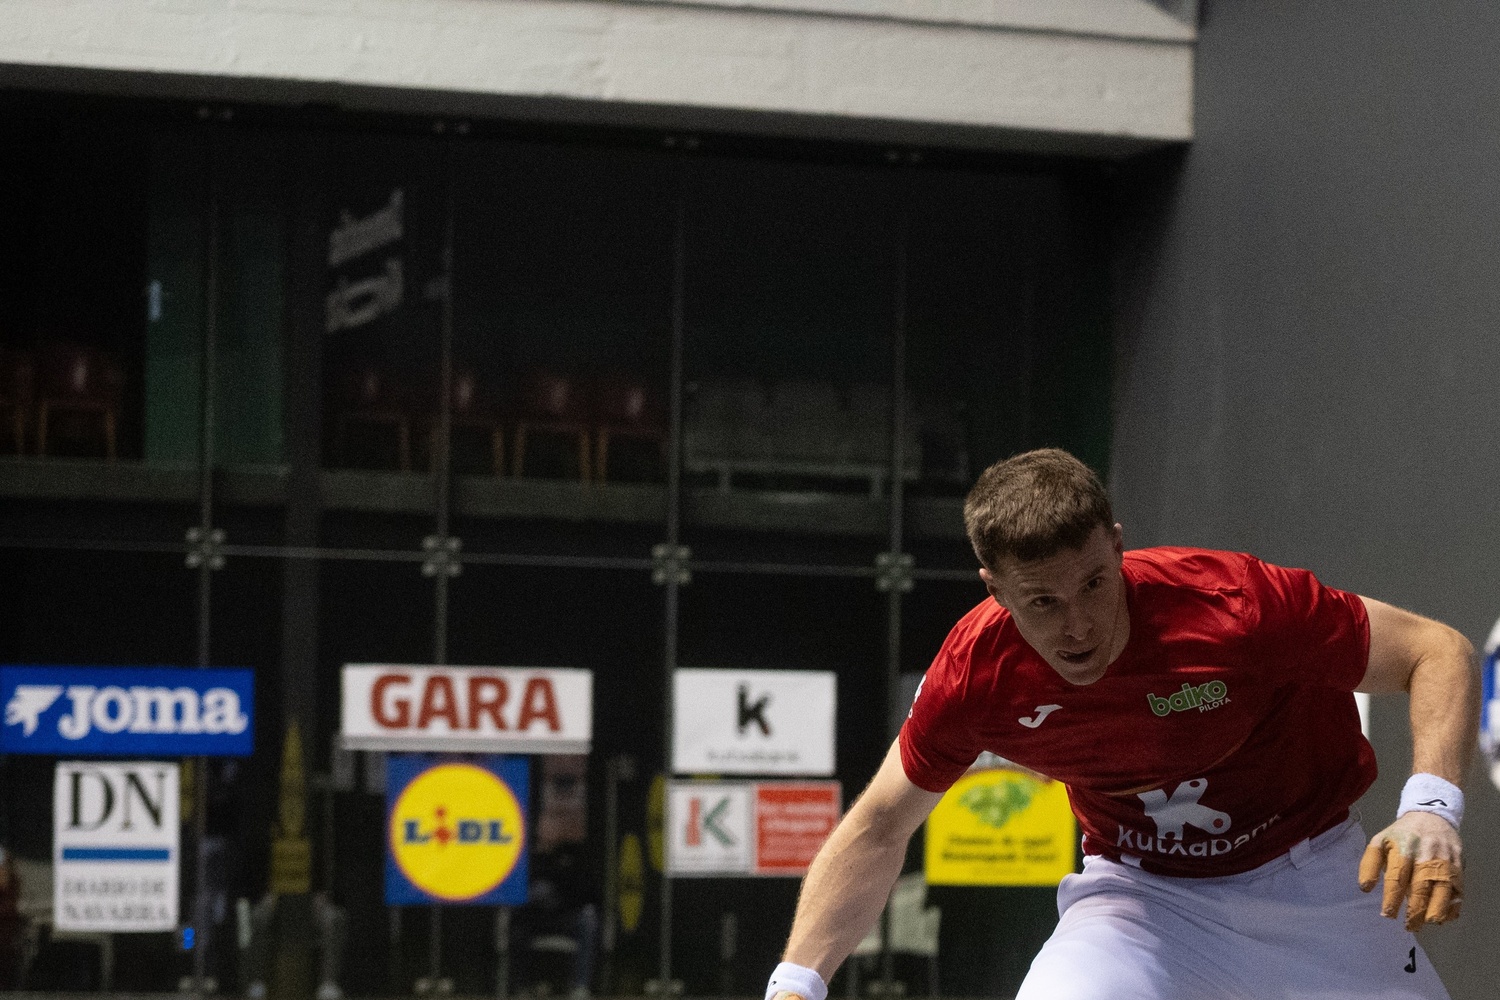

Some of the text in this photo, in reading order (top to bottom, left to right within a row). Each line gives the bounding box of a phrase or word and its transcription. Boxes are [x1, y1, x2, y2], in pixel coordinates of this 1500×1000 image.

[370, 674, 562, 732] GARA
[1147, 680, 1227, 717] baiko
[1199, 697, 1232, 713] PILOTA
[67, 770, 168, 831] DN
